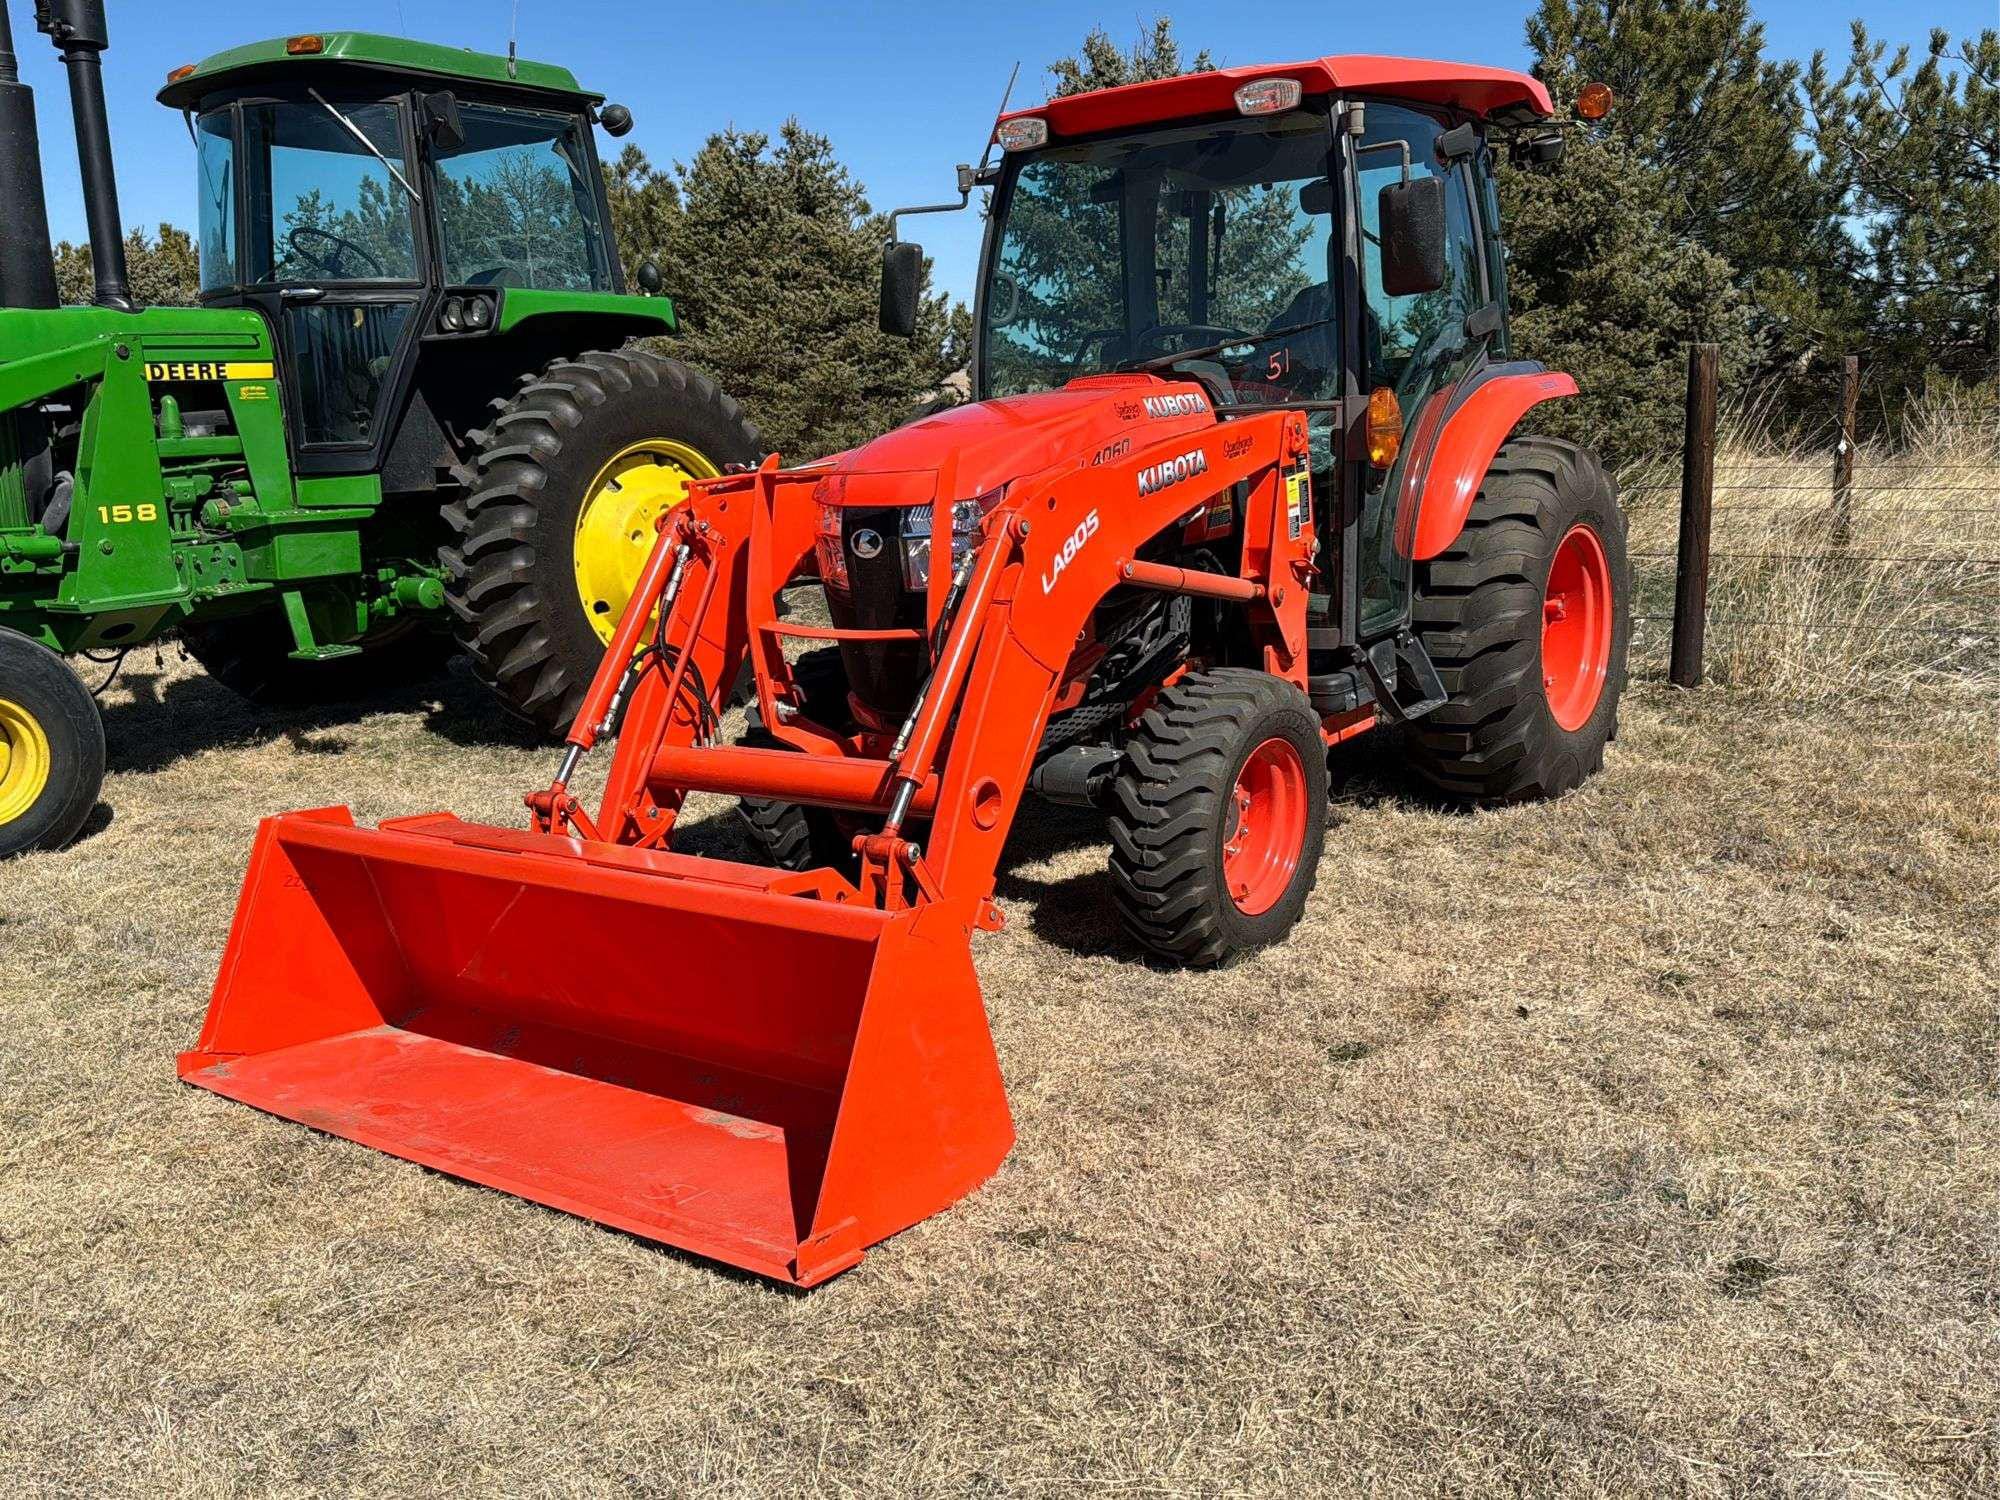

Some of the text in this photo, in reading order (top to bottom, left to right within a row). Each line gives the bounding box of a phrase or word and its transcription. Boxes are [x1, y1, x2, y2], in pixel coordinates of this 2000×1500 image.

[149, 364, 228, 379] DEERE
[1265, 348, 1289, 380] 51
[1143, 393, 1209, 418] KUBOTA
[1081, 438, 1130, 467] 4060
[1137, 448, 1207, 497] KUBOTA
[98, 504, 157, 524] 158
[1042, 508, 1100, 595] LA805
